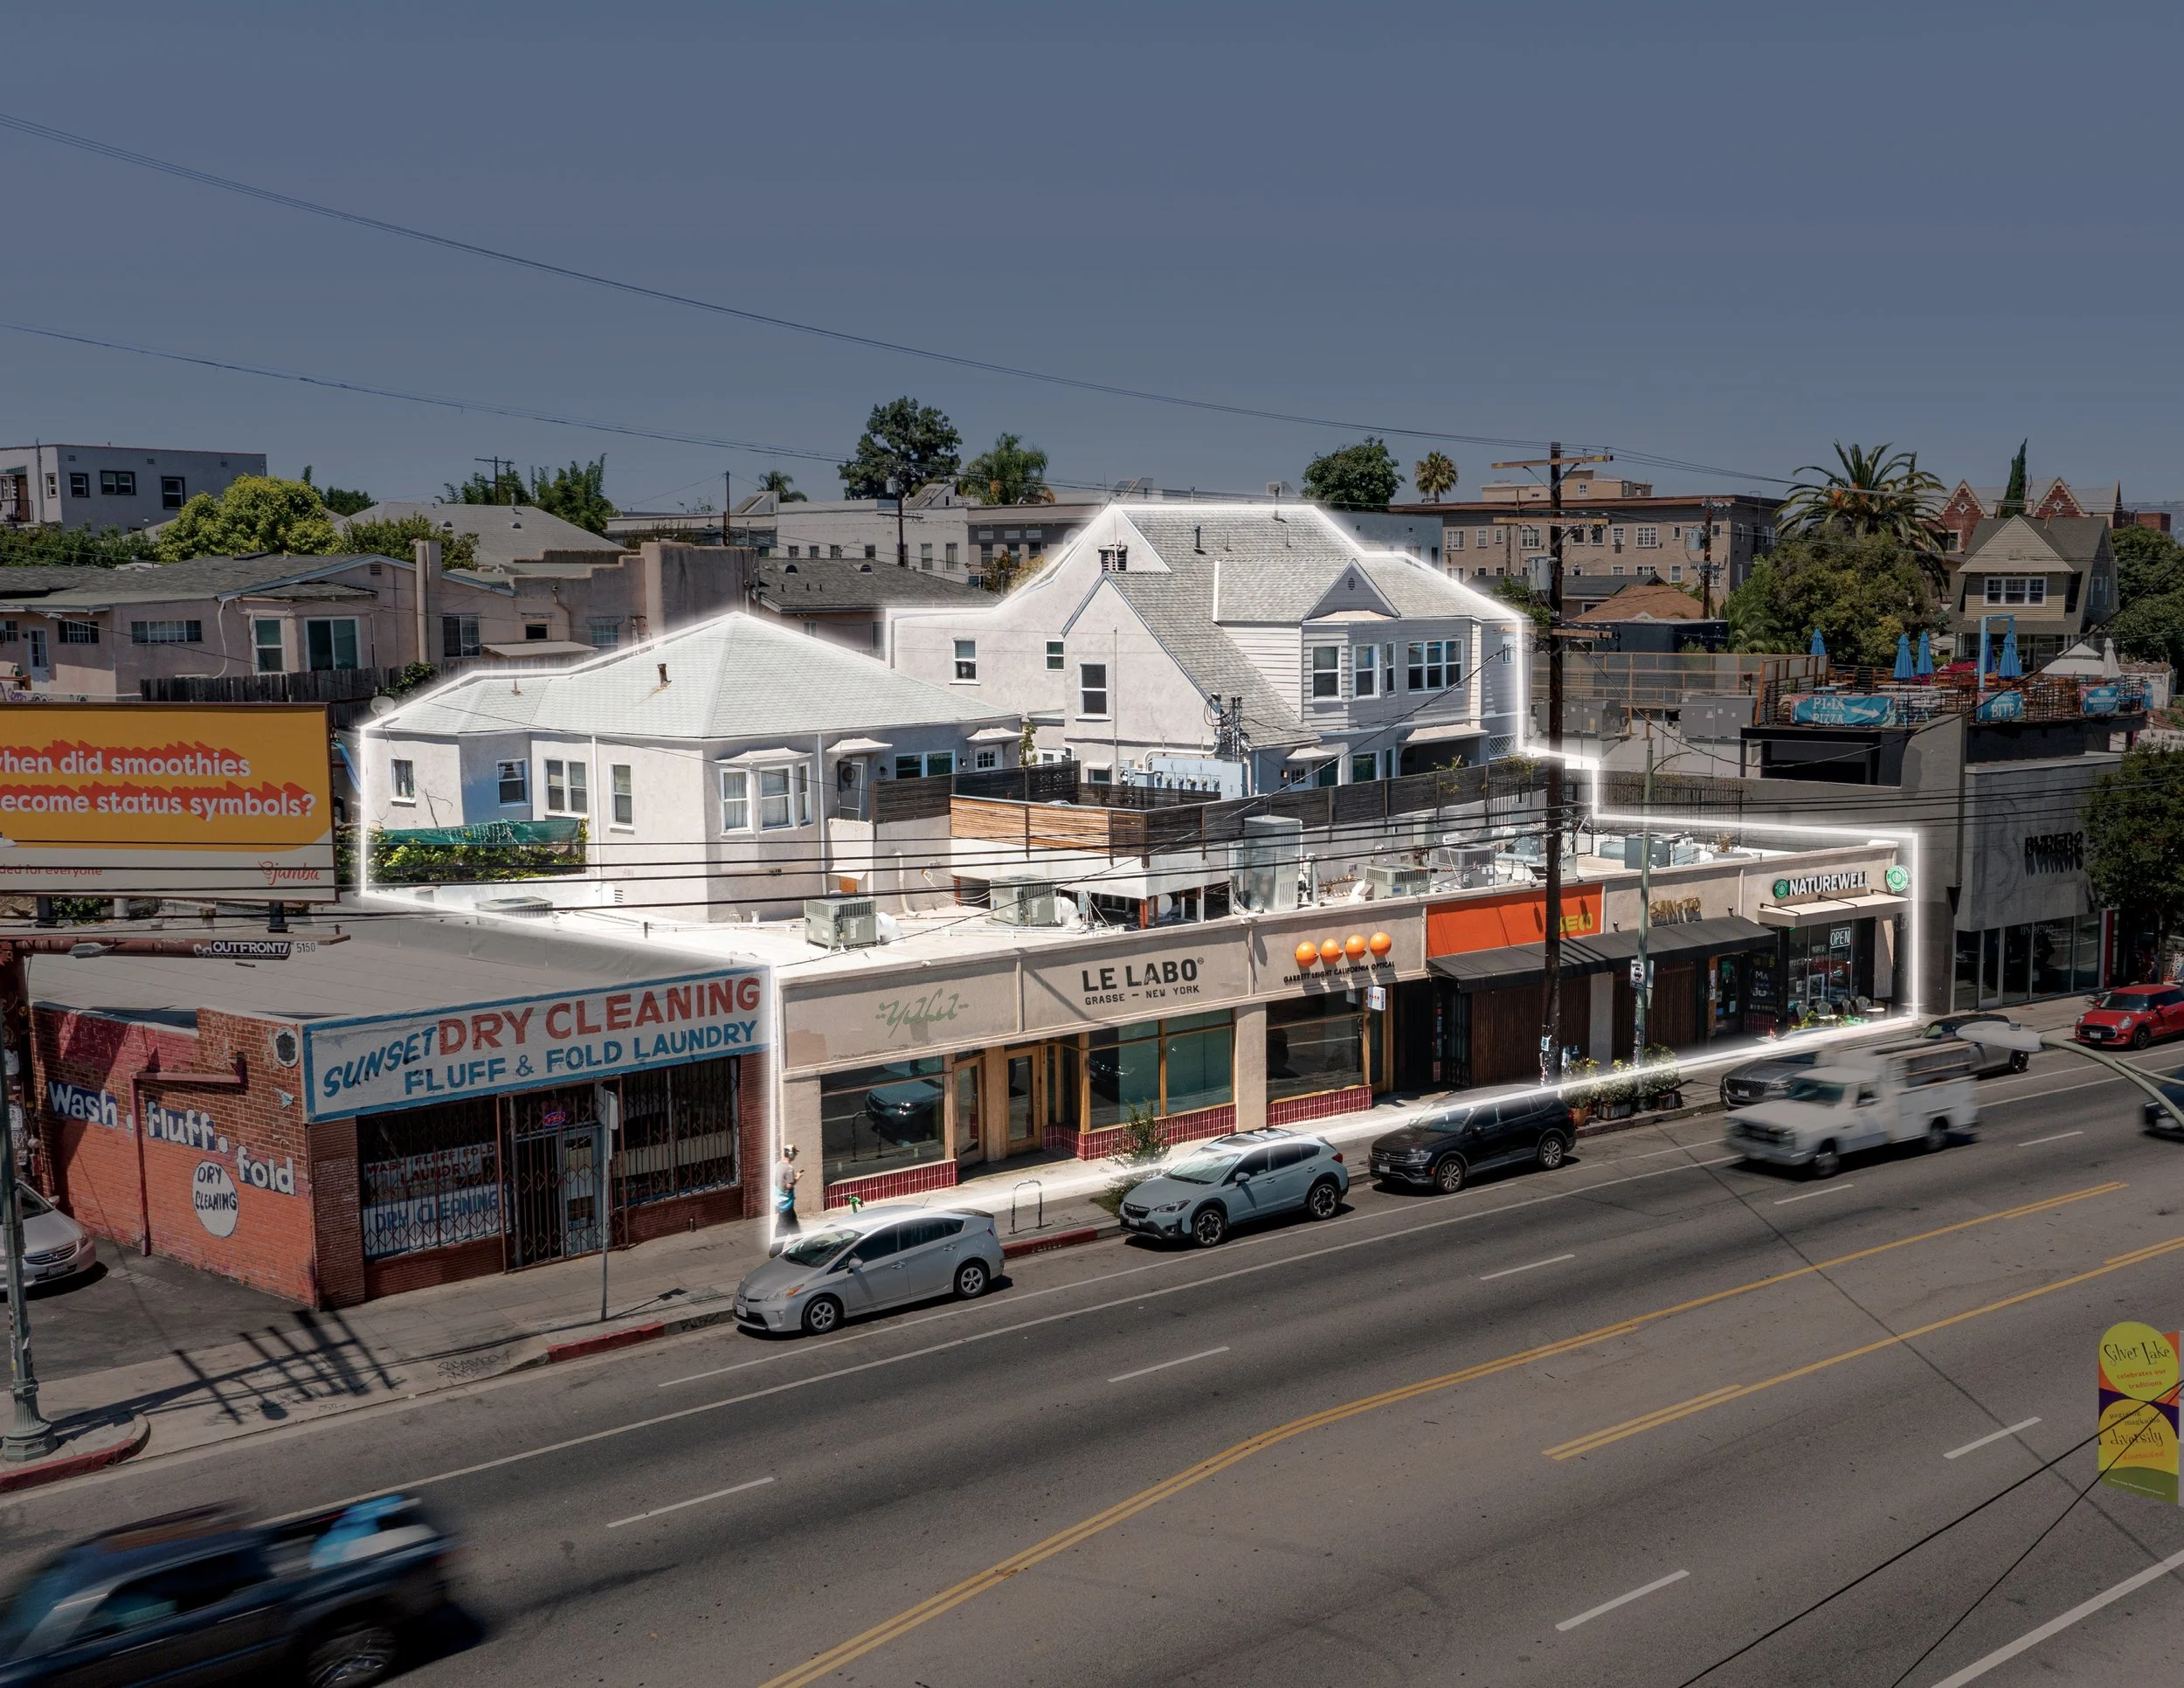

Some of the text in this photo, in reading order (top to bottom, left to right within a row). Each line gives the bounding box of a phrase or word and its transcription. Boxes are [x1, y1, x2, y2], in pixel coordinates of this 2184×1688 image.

[1812, 713, 1844, 724] PIZZA
[1991, 703, 2015, 718] BITE
[0, 751, 251, 777] hen did smoothies
[0, 792, 316, 822] ecome status symbols?
[26, 864, 41, 875] for
[45, 868, 102, 878] everyone
[1789, 871, 1868, 896] NATUREWELL
[296, 940, 315, 953] 5150
[1830, 930, 1850, 946] OPEN
[1082, 965, 1117, 993] LE
[1283, 961, 1395, 983] GARRETT LEIGHT CALIFORNIA OPTICAL
[1085, 992, 1125, 1006] GRASSE
[1145, 987, 1166, 1000] NEW
[1172, 985, 1199, 996] YORK
[323, 977, 761, 1098] SUNSET DRY CLEANING
[404, 1020, 757, 1096] FLUFF & FOLD LAUNDRY
[49, 1081, 118, 1126] Wash
[236, 1145, 295, 1195] fold
[366, 1144, 495, 1175] WASH FLUFF FOLD
[197, 1166, 222, 1184] DRY
[399, 1161, 471, 1186] LAUNDRY
[195, 1190, 237, 1211] CLEANING
[375, 1191, 498, 1232] DRY CLEANING
[2104, 1340, 2170, 1366] Silver Lake
[2117, 1370, 2153, 1380] celebrates
[2128, 1380, 2163, 1389] traditions
[2110, 1428, 2164, 1448] diversity
